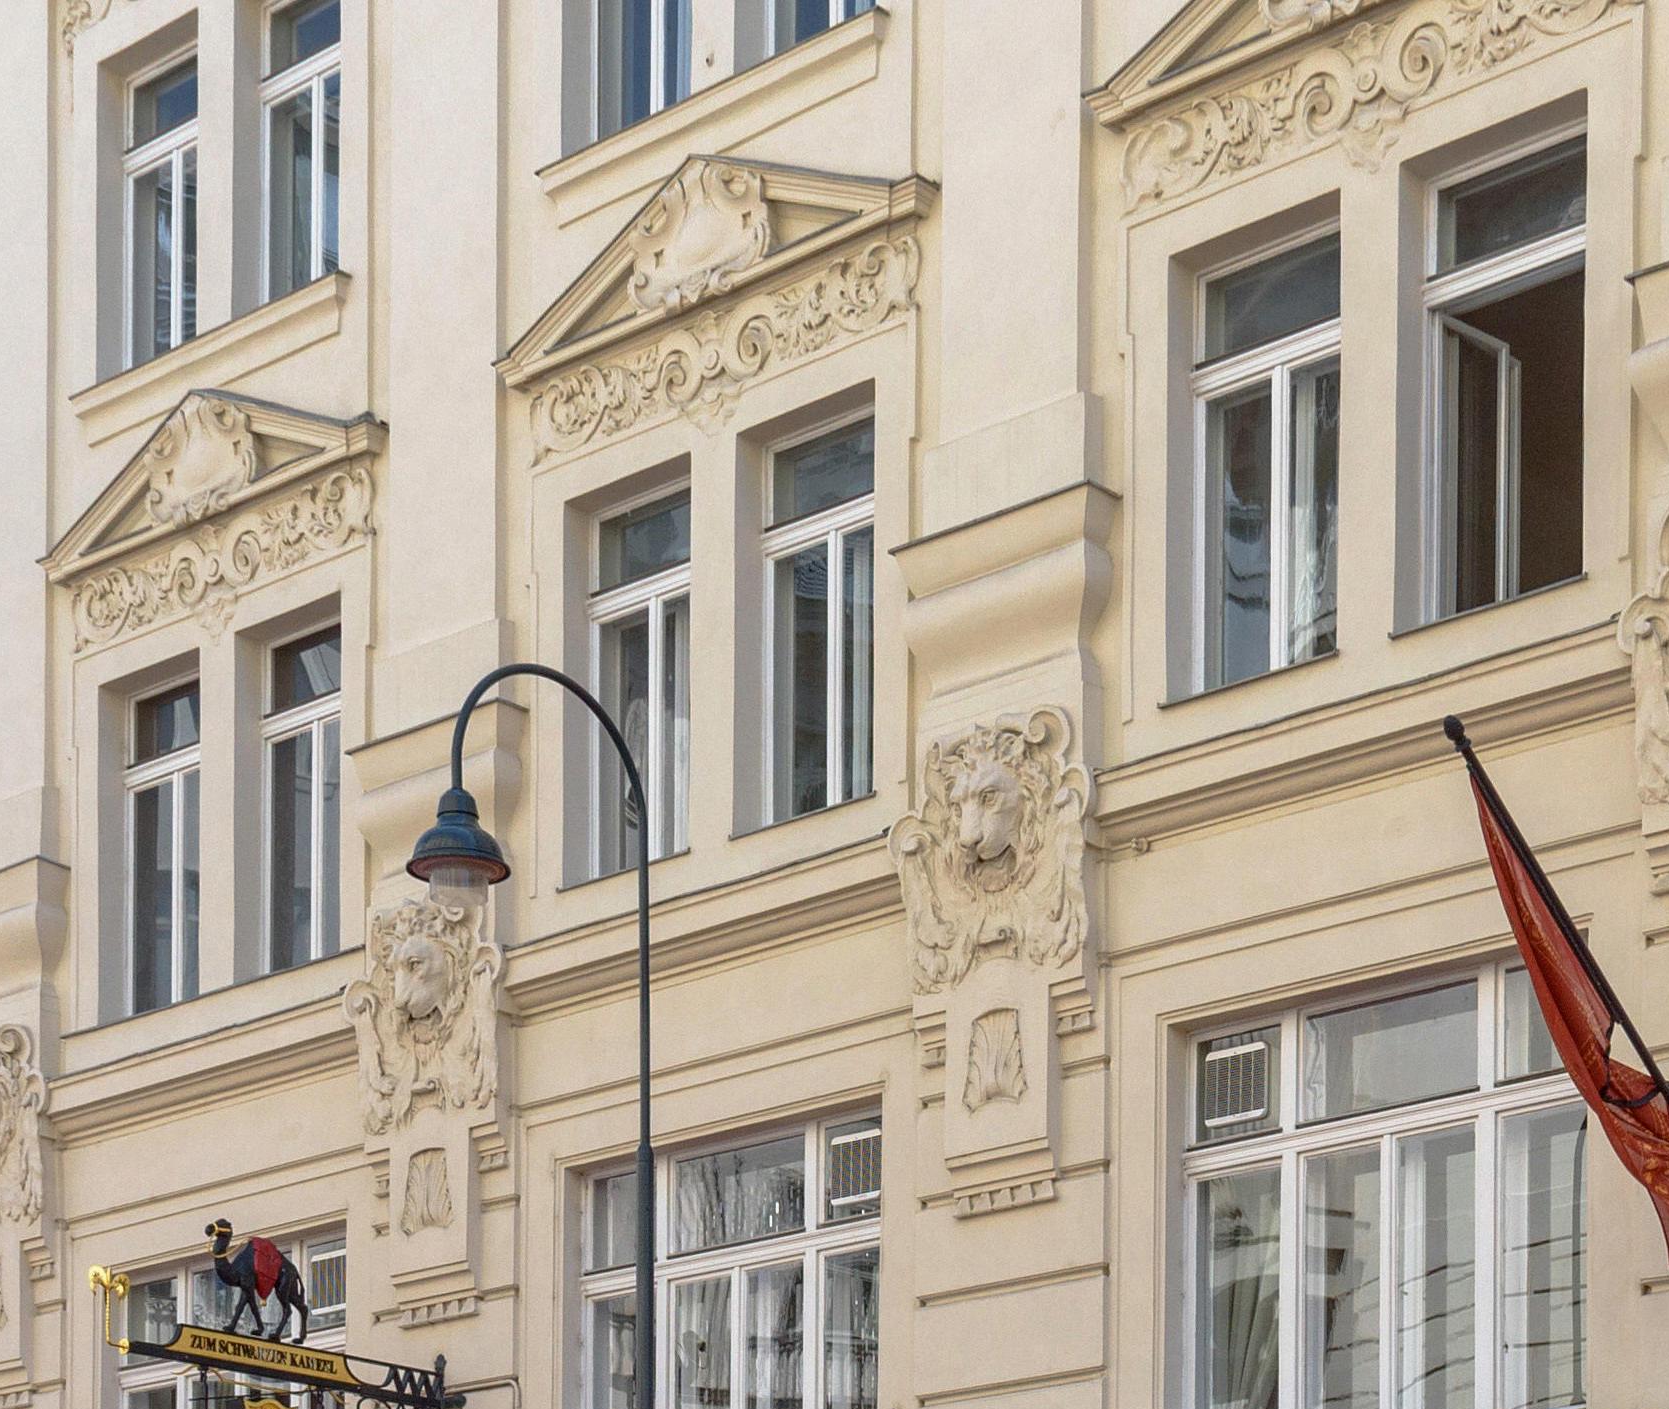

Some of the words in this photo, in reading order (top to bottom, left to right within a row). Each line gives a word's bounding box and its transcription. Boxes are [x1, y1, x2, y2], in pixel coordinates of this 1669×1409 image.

[190, 1334, 217, 1351] ZUM
[218, 1340, 288, 1366] SCHWARZEN
[289, 1352, 338, 1375] KAMEEL
